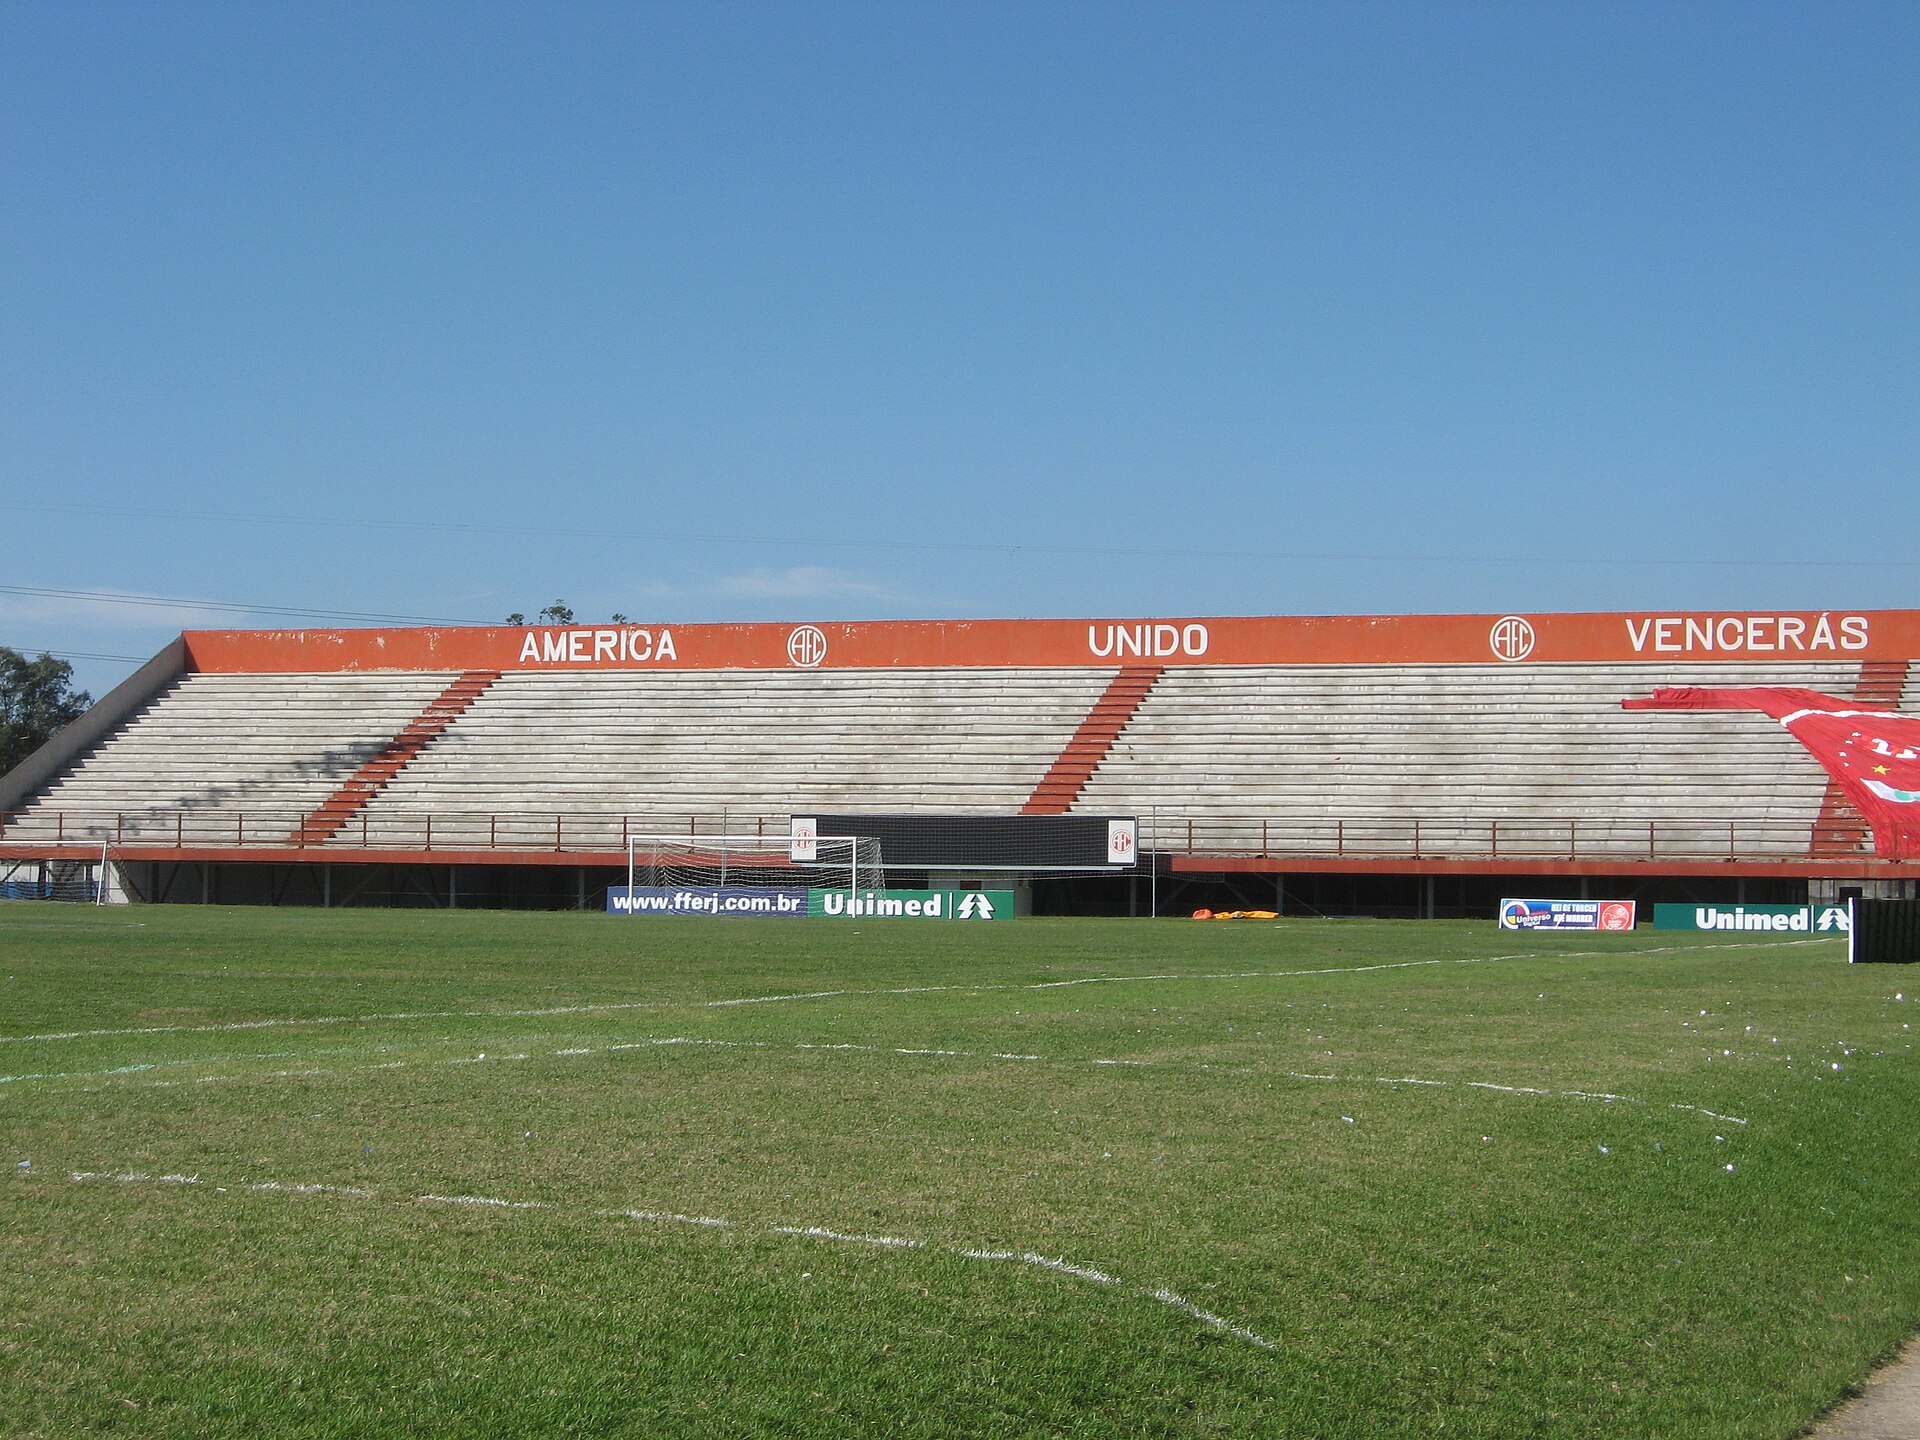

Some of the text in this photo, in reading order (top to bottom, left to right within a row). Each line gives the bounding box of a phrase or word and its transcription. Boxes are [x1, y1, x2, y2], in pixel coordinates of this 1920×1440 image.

[519, 612, 1869, 662] AMERICA UNIDO VENCERÁS
[789, 627, 826, 665] AFC
[1491, 618, 1534, 660] AFC
[613, 892, 800, 914] www.fferj.com.br
[823, 893, 942, 917] Unimed
[1516, 913, 1552, 923] Universo
[1695, 907, 1808, 931] Unimed
